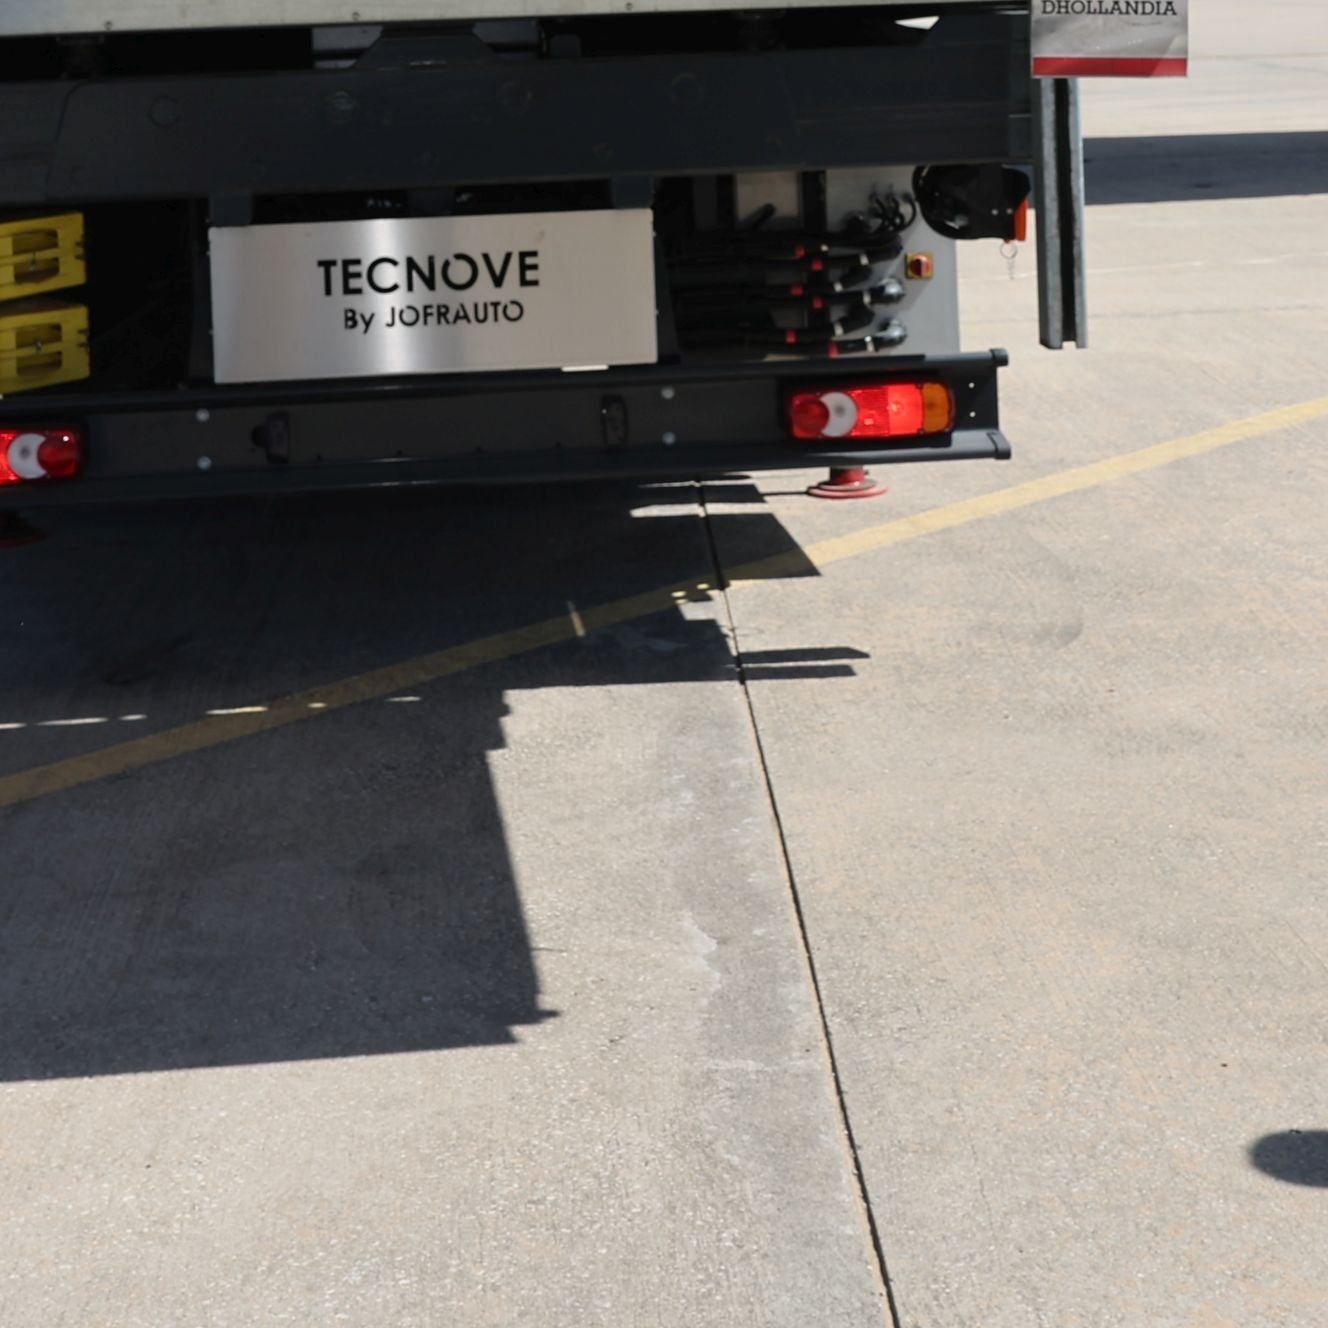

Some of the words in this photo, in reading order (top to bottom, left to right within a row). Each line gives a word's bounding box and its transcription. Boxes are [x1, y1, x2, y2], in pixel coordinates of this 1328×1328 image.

[1041, 0, 1178, 16] DHOLLANDIA
[316, 250, 540, 297] TECNOVE
[343, 308, 375, 334] By
[386, 299, 524, 329] JOFRAUTO
